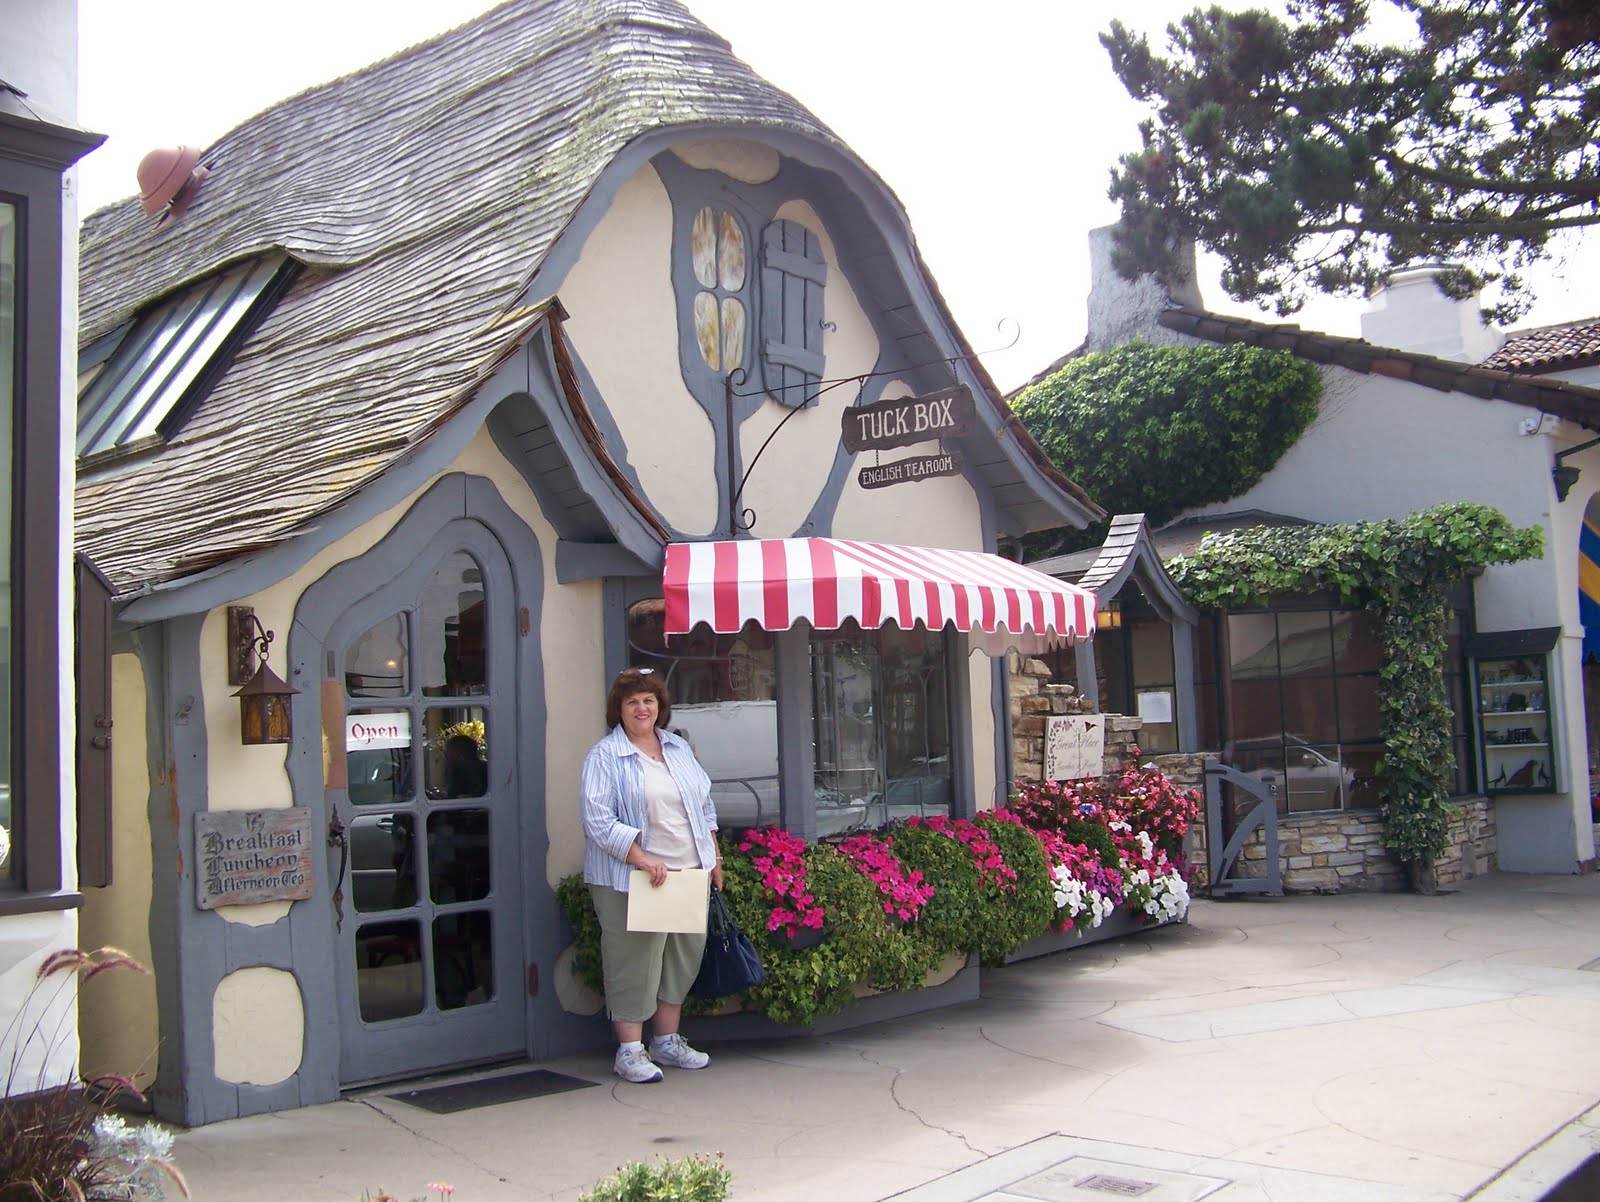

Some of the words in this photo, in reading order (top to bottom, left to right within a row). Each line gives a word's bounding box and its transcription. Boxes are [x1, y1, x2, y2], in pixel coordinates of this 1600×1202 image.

[857, 406, 910, 440] TUCK
[914, 398, 955, 432] BOX
[861, 465, 902, 485] ENGLISH
[904, 456, 953, 477] TEAROOM
[351, 723, 399, 744] Open
[202, 829, 302, 855] Breakfast
[203, 853, 298, 877] Luncheon
[204, 875, 280, 895] Afternoon
[281, 867, 304, 887] Tea
